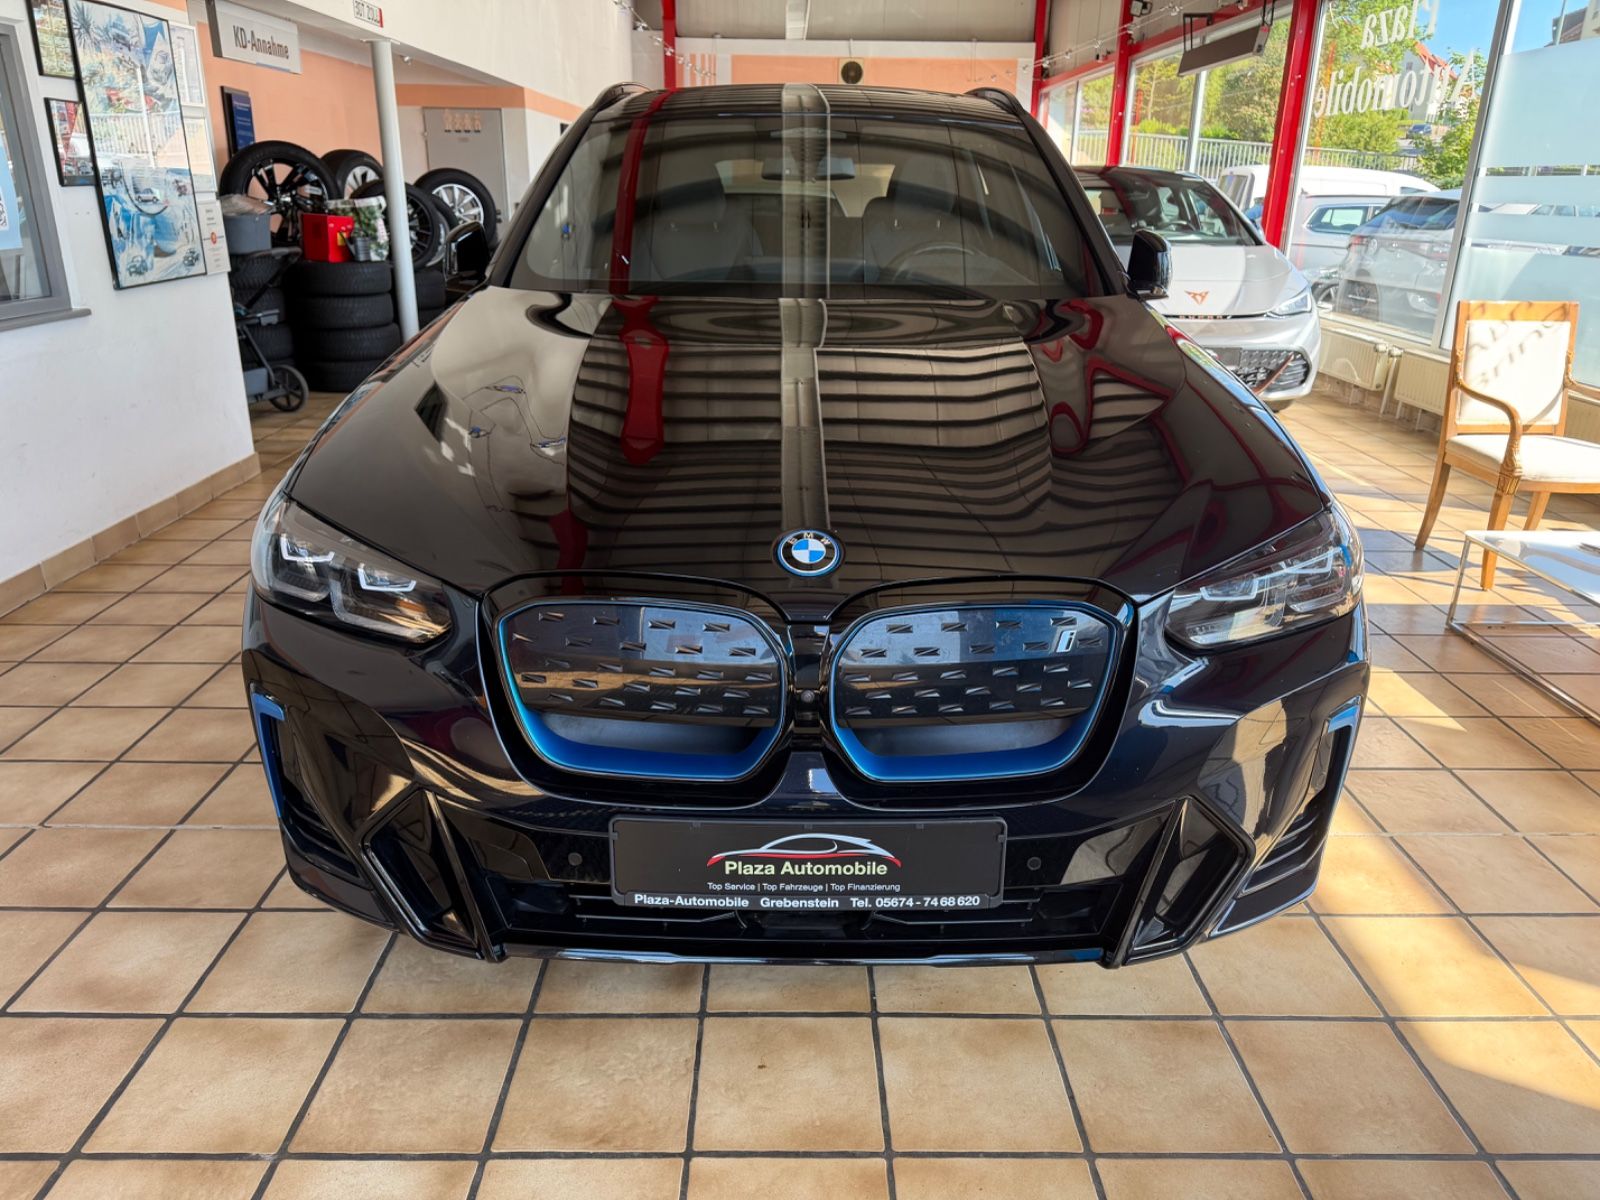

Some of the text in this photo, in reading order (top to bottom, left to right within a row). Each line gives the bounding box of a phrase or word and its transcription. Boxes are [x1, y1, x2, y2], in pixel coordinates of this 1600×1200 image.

[232, 24, 289, 60] KD-Annahme
[724, 860, 888, 876] Plaza Automobile
[707, 882, 723, 891] Top
[724, 882, 756, 891] Service
[762, 883, 778, 892] Top
[779, 883, 824, 893] Fahrzeuge
[830, 883, 846, 892] Top
[847, 883, 901, 893] Finanzierung
[634, 894, 750, 908] Plaza-Automobile
[760, 897, 839, 908] Grebenstein
[850, 897, 872, 908] Tel.
